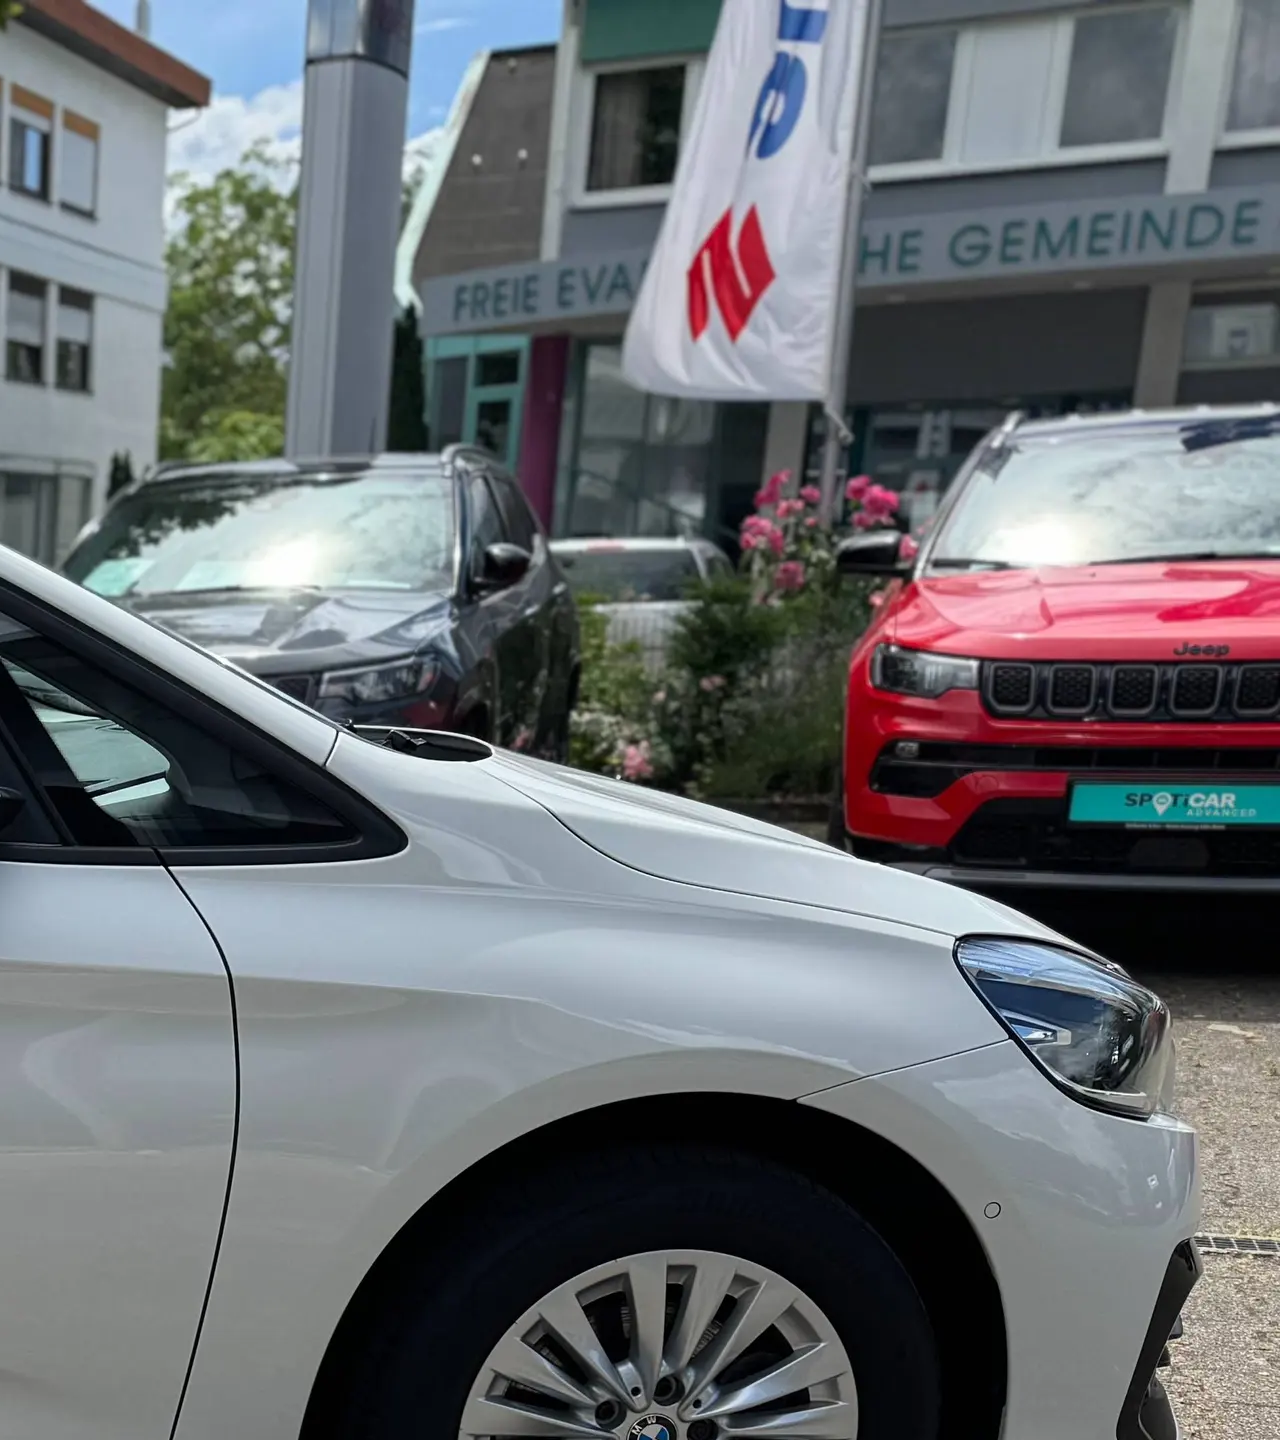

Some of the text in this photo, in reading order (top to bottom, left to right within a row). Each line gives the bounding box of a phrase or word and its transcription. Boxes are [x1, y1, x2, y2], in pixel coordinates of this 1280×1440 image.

[453, 274, 539, 322] FREIE
[557, 257, 650, 309] EVA
[948, 199, 1263, 268] GEMEINDE
[1173, 642, 1230, 657] Jeep
[1186, 808, 1257, 818] ADVANCED
